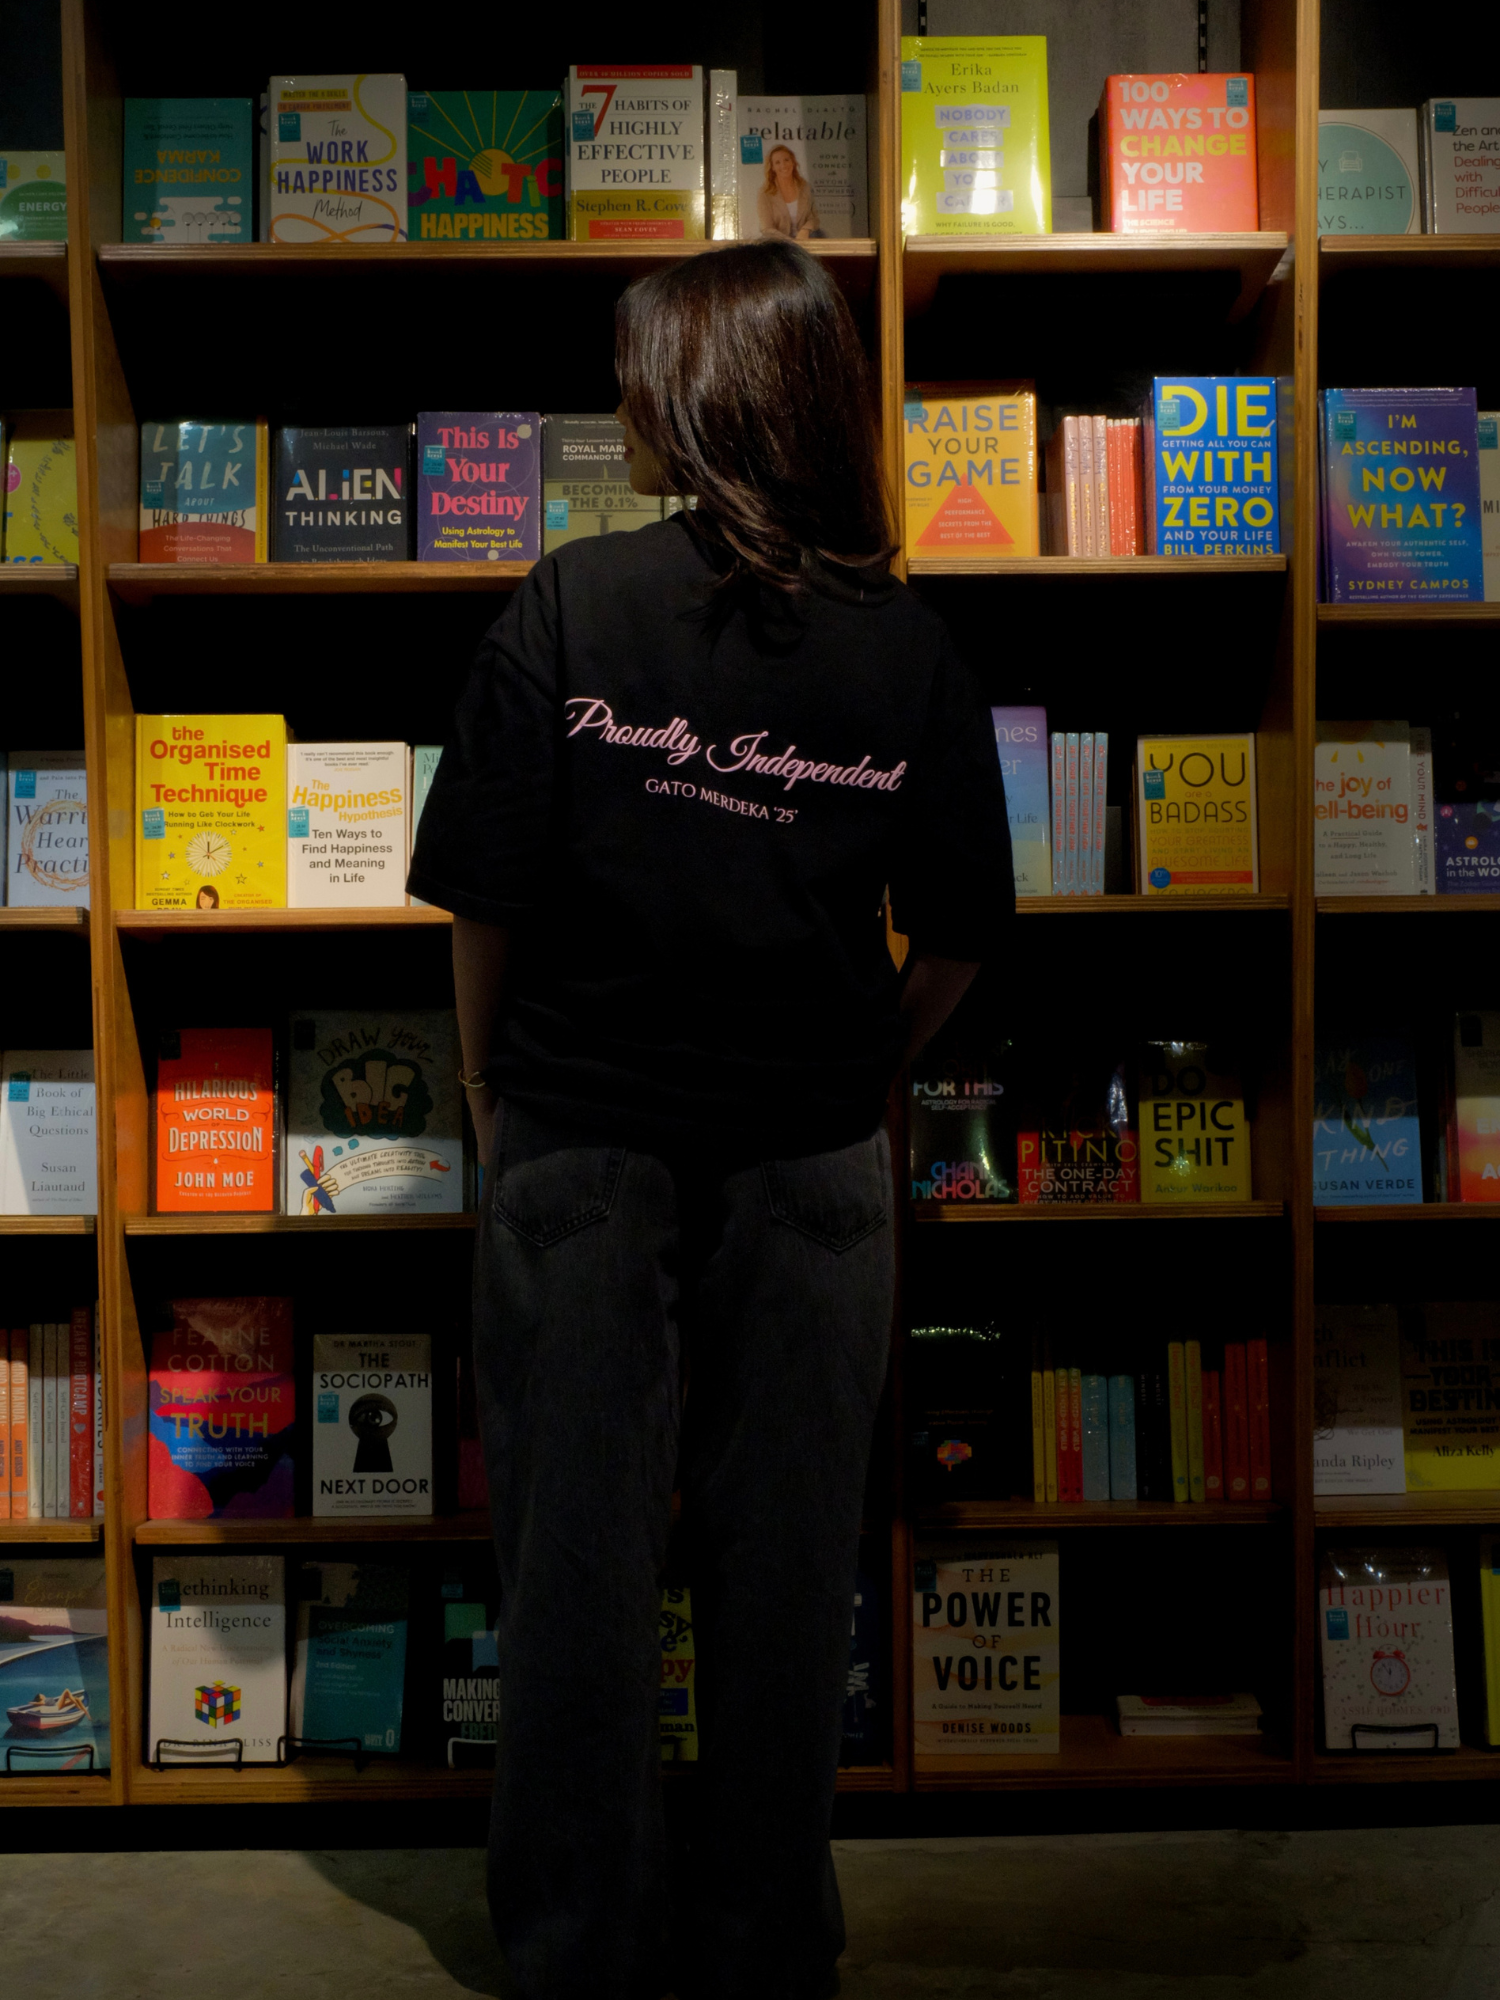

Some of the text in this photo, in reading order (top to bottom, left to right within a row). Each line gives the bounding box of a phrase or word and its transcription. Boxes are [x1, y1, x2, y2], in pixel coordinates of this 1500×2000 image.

[951, 63, 992, 76] Erika
[924, 81, 1019, 94] Ayers Badan
[1119, 81, 1169, 103] 100
[578, 84, 692, 138] THE 7 HABITS OF
[940, 110, 1006, 121] NOBODY
[1120, 107, 1249, 130] WAYS TO
[327, 120, 348, 138] The
[610, 121, 683, 136] HIGHLY
[748, 121, 856, 141] relatable
[1452, 125, 1477, 136] Zen
[306, 140, 369, 164] WORK
[577, 144, 695, 160] EFFECTIVE
[1120, 134, 1247, 157] CHANGE
[1453, 140, 1475, 151] the
[277, 168, 398, 194] HAPPINESS
[601, 169, 672, 184] PEOPLE
[1121, 162, 1204, 184] YOUR
[1454, 171, 1482, 182] with
[19, 202, 67, 211] ENERGY
[312, 196, 362, 221] Method
[576, 199, 651, 216] Stephen R.
[1121, 189, 1183, 211] LIFE
[420, 213, 550, 239] HAPPINESS
[907, 404, 1019, 434] RAISE
[1161, 385, 1271, 437] DIE
[1388, 414, 1417, 429] I'M
[153, 425, 245, 454] LET'S
[437, 426, 519, 449] This Is
[927, 437, 998, 455] YOUR
[1162, 440, 1271, 448] GETTING ALL YOU CAN
[563, 445, 596, 453] ROYAL
[1341, 440, 1469, 458] ASCENDING,
[158, 462, 242, 490] TALK
[446, 458, 510, 483] Your
[907, 458, 1020, 488] GAME
[1161, 451, 1272, 483] WITH
[285, 467, 402, 501] ALIEN
[1362, 466, 1447, 492] NOW
[184, 497, 215, 506] ABOUT
[431, 490, 529, 521] Destiny
[571, 497, 638, 508] THE 0.1%
[152, 509, 246, 528] HARD THINGS
[285, 510, 402, 526] THINKING
[1163, 497, 1274, 527] ZERO
[1347, 503, 1466, 528] WHAT?
[442, 527, 464, 536] Using
[467, 527, 505, 537] Astrology
[1164, 531, 1273, 541] AND YOUR LIFE
[434, 540, 522, 548] Manifest Your Best Life
[1163, 544, 1274, 555] BILL PERKINS
[1348, 579, 1469, 590] SYDNEY CAMPOS
[172, 726, 204, 741] the
[150, 740, 271, 765] Organised
[564, 697, 907, 792] Proudly Independent
[204, 762, 261, 781] Time
[1150, 752, 1245, 788] YOU
[312, 779, 330, 791] The
[1338, 772, 1392, 798] joy of
[150, 784, 268, 808] Technique
[292, 785, 403, 812] Happiness
[645, 778, 696, 798] GATO
[700, 787, 769, 821] MERDEKA
[338, 806, 403, 823] Hypothesis
[1150, 801, 1247, 824] BADASS
[164, 821, 195, 829] Running
[312, 829, 382, 840] Ten Ways to
[302, 844, 393, 855] Find Happiness
[309, 858, 385, 870] and Meaning
[329, 873, 365, 883] in Life
[316, 1027, 380, 1066] DRAW
[36, 1088, 83, 1098] Book of
[175, 1079, 258, 1102] HILARIOUS
[331, 1060, 416, 1112] BIG
[27, 1106, 93, 1119] Big Ethical
[182, 1108, 250, 1122] WORLD
[1153, 1101, 1235, 1131] EPIC
[29, 1124, 89, 1138] Questions
[169, 1127, 263, 1153] DEPRESSION
[1021, 1140, 1137, 1163] PITINO
[1154, 1137, 1235, 1168] SHIT
[41, 1162, 76, 1173] Susan
[1022, 1168, 1137, 1180] THE ONE-DAY
[31, 1181, 85, 1192] Liautaud
[175, 1171, 254, 1188] JOHN MOE
[1028, 1181, 1132, 1193] CONTRACT
[1366, 1178, 1415, 1190] VERDE
[911, 1180, 1010, 1200] NICHOLAS
[168, 1354, 275, 1372] COTTON
[359, 1353, 390, 1368] THE
[320, 1374, 428, 1388] SOCIOPATH
[160, 1387, 282, 1404] SPEAK YOUR
[170, 1413, 269, 1439] TRUTH
[1466, 1444, 1495, 1458] Kelly
[1352, 1454, 1395, 1470] Ripley
[321, 1479, 428, 1494] NEXT DOOR
[962, 1569, 1011, 1582] THE
[1326, 1581, 1445, 1611] Happier
[923, 1592, 1051, 1627] POWER
[166, 1611, 271, 1633] Intelligence
[1356, 1614, 1421, 1638] Hour
[972, 1635, 1002, 1648] OF
[933, 1656, 1041, 1691] VOICE
[943, 1723, 1031, 1734] DENISE WOODS
